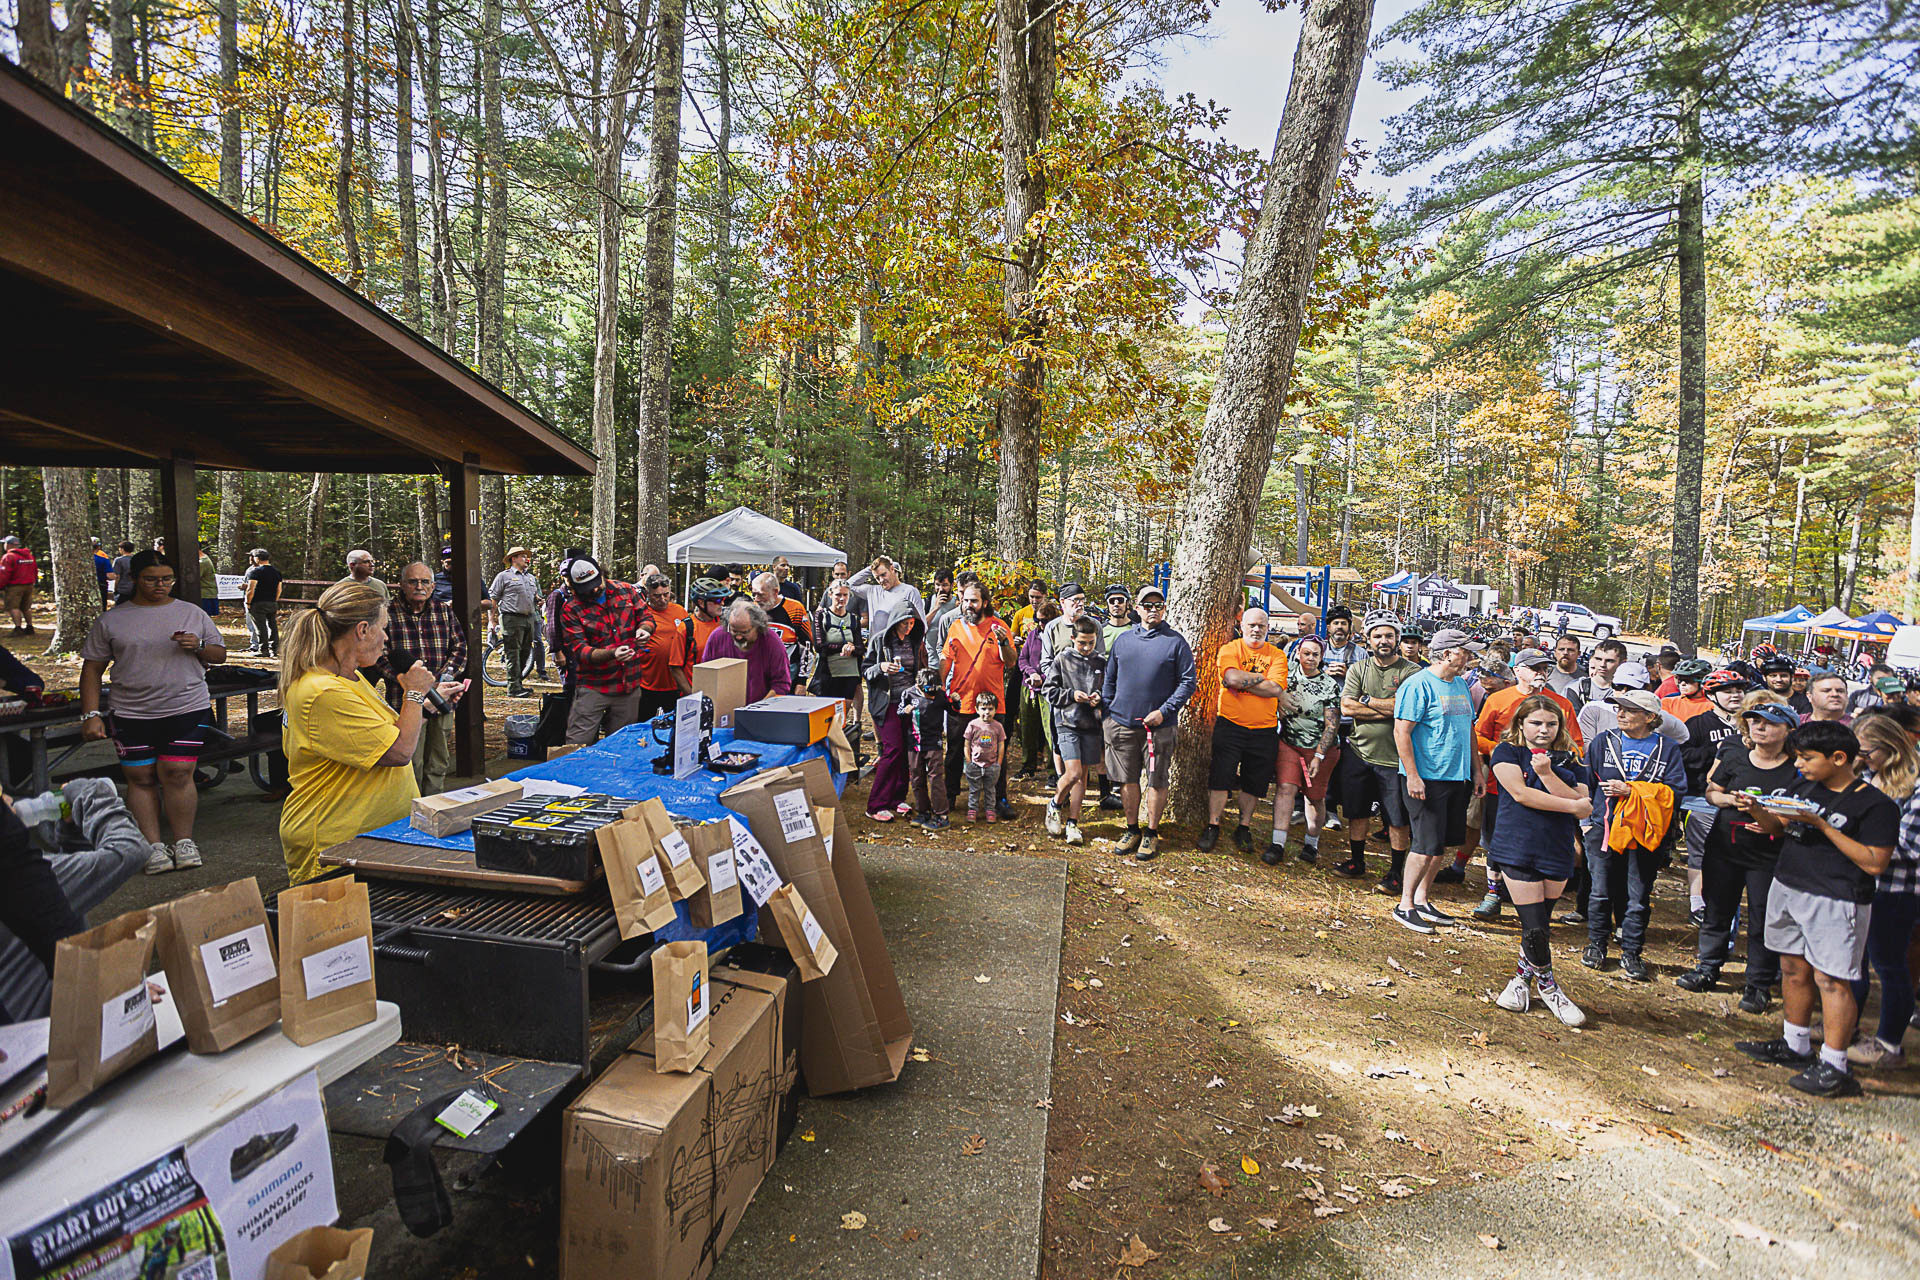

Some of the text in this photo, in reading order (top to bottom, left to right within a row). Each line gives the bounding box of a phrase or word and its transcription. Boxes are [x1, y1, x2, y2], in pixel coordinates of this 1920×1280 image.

[1709, 728, 1732, 742] OLD
[237, 1196, 285, 1238] SHIMANO
[285, 1172, 314, 1202] SHOES
[247, 1160, 304, 1208] SHIMANO
[31, 1209, 91, 1258] START
[93, 1189, 128, 1223] OUT
[250, 1189, 308, 1242] $250 VALUE!
